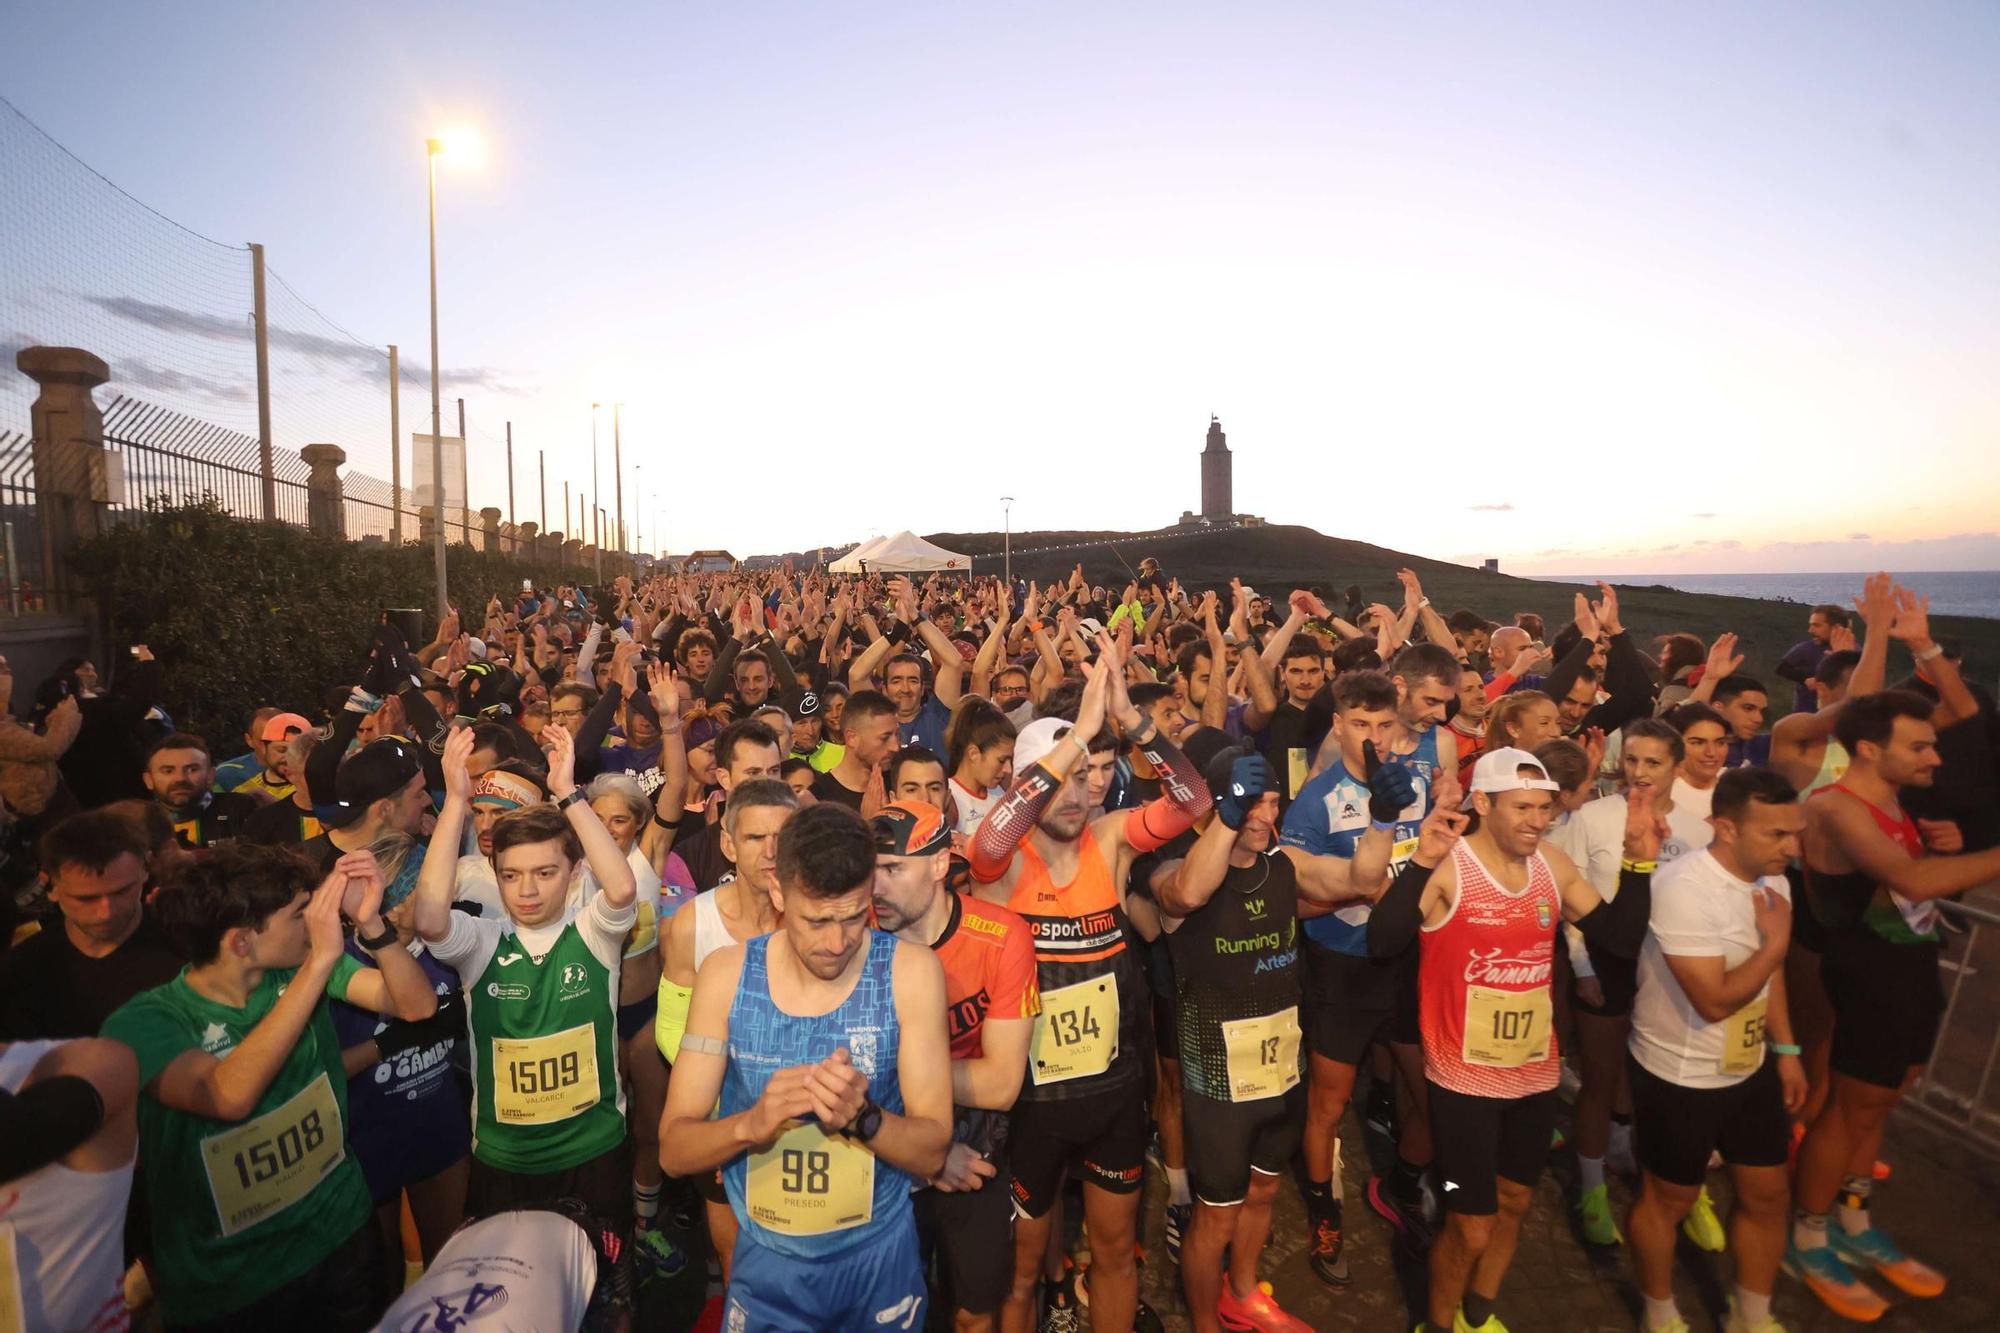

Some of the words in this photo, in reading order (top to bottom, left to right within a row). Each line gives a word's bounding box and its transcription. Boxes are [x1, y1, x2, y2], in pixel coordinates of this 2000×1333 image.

[1029, 912, 1116, 941] osportlimit
[1215, 932, 1280, 954] Running
[1050, 1005, 1101, 1047] 134
[1493, 1010, 1534, 1040] 107
[374, 1063, 392, 1083] O
[509, 1051, 579, 1094] 1509
[525, 1093, 565, 1104] VALCARCE
[234, 1108, 325, 1189] 1508
[782, 1149, 830, 1194] 98
[784, 1197, 826, 1209] PRESEDO
